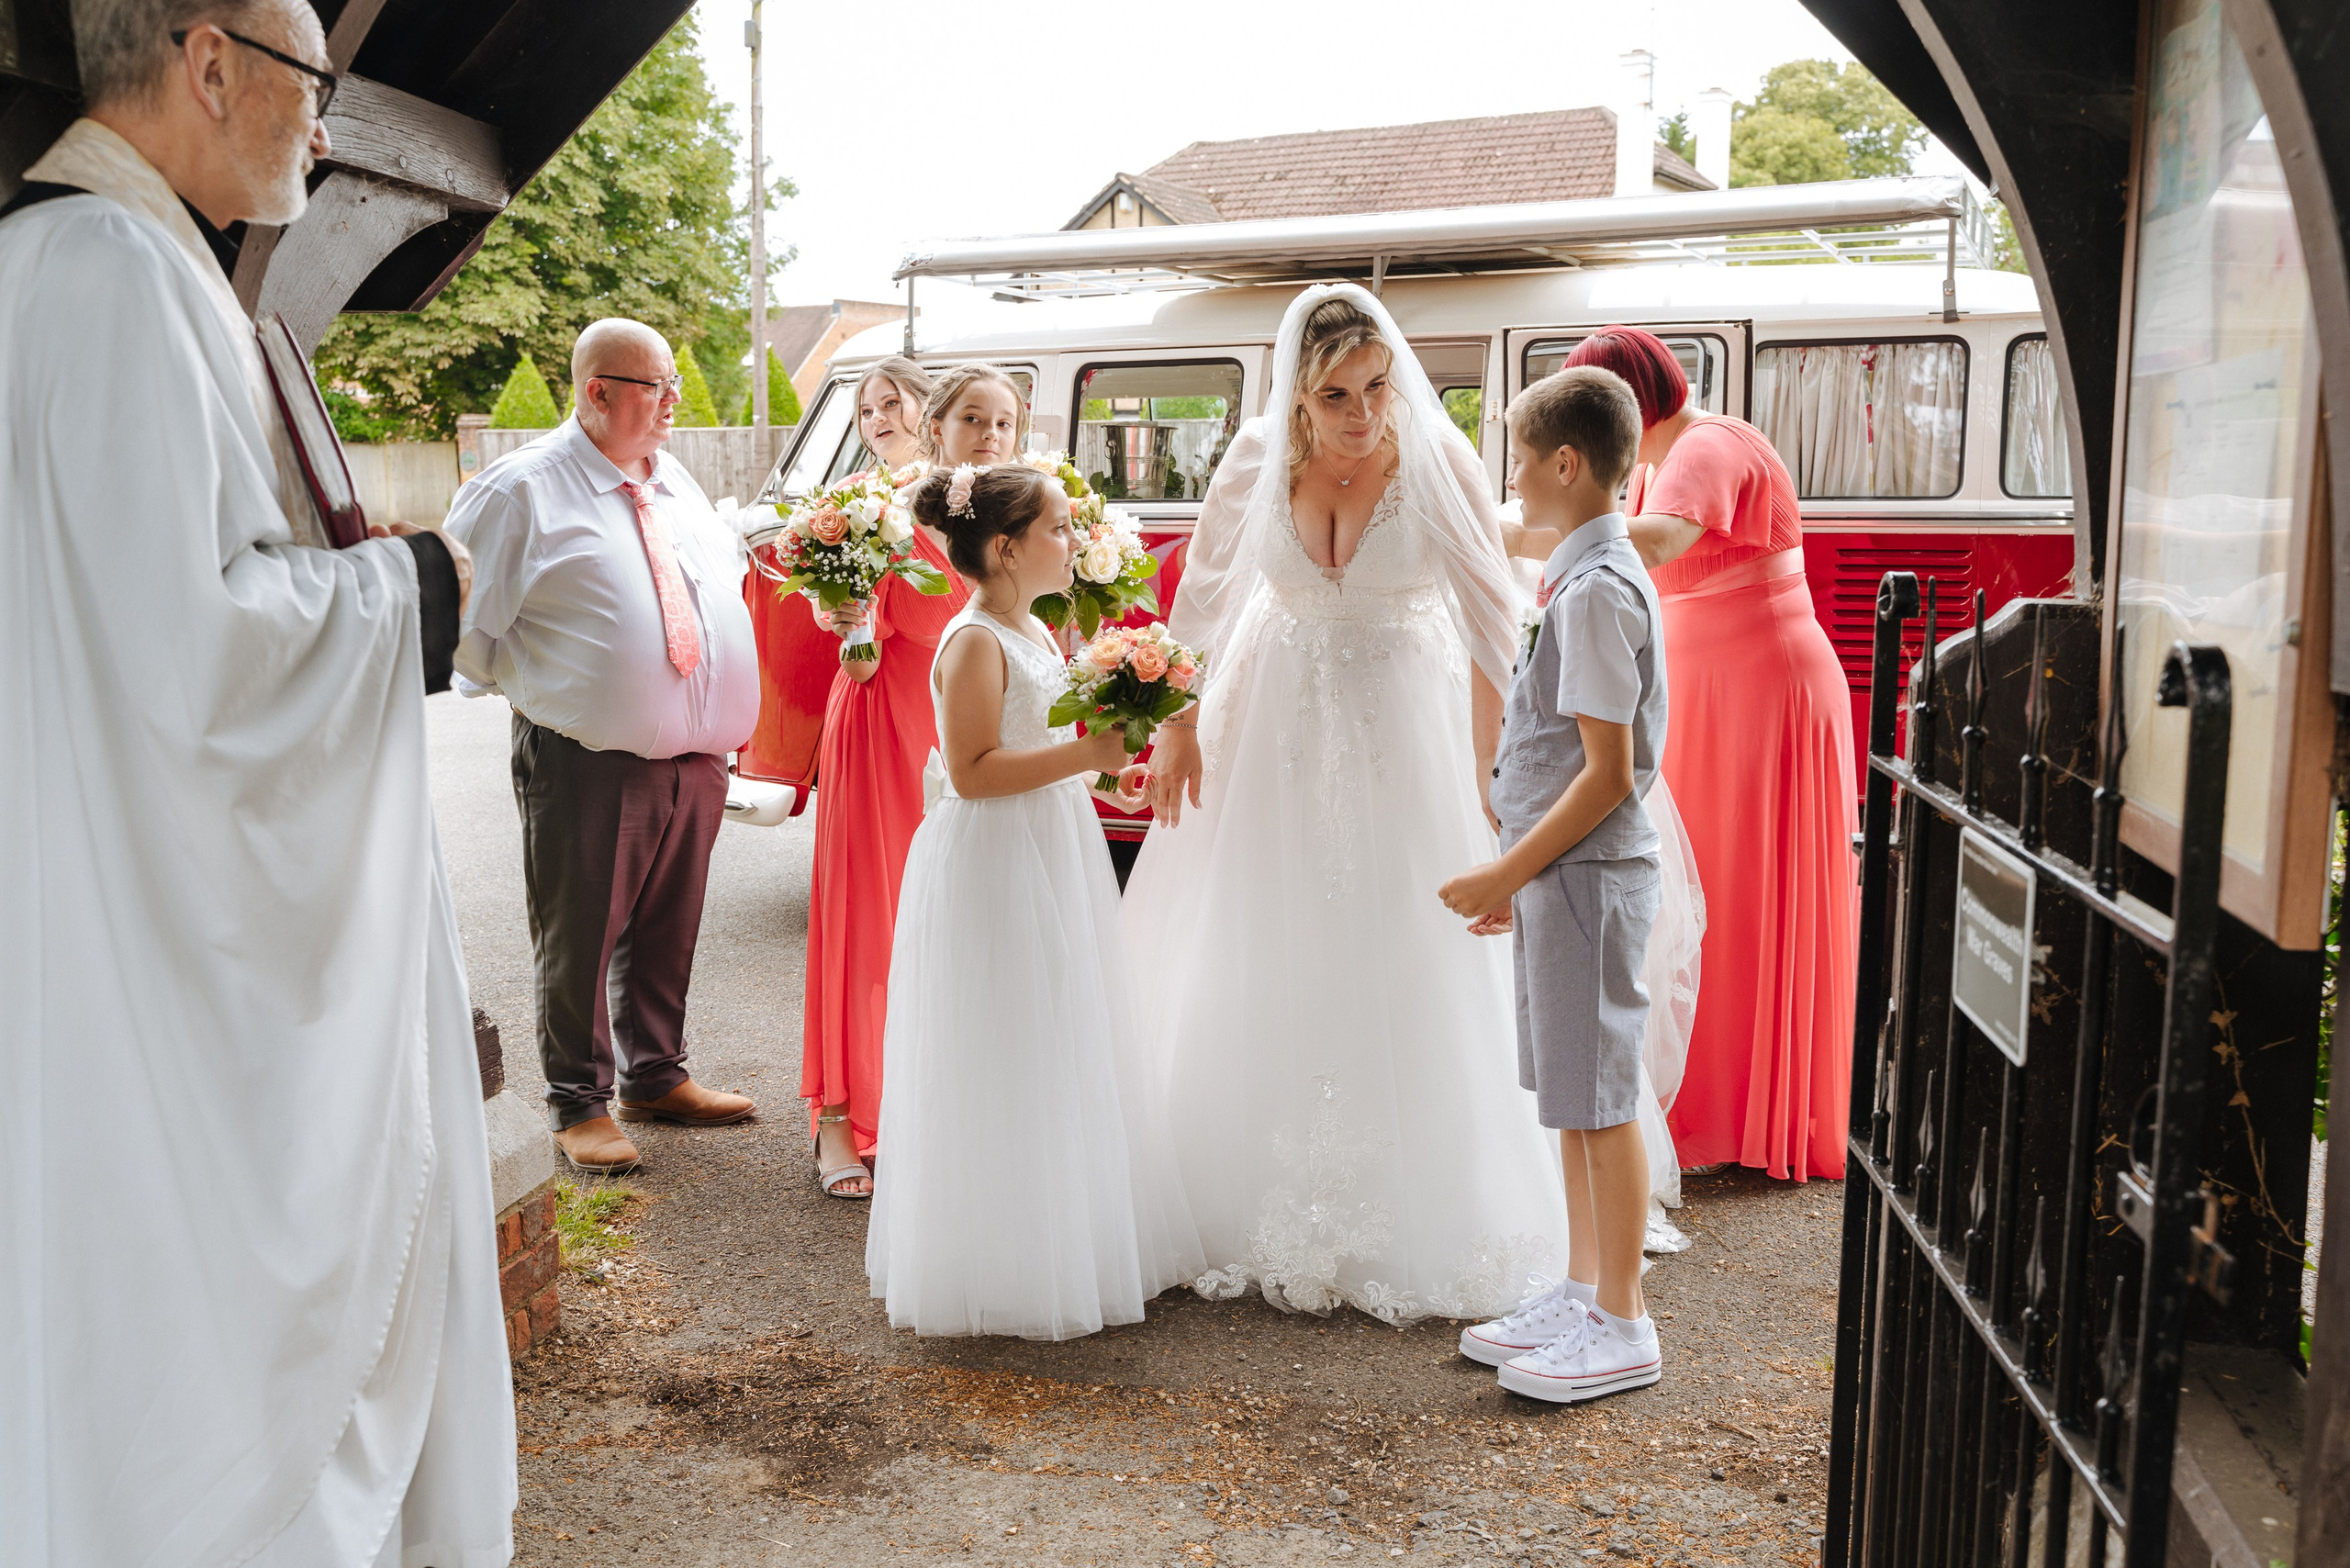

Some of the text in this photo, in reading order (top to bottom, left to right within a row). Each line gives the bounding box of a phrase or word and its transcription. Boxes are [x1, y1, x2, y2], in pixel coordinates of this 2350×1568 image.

[1962, 887, 2023, 957] Commonwealth
[1966, 924, 2013, 984] War Graves
